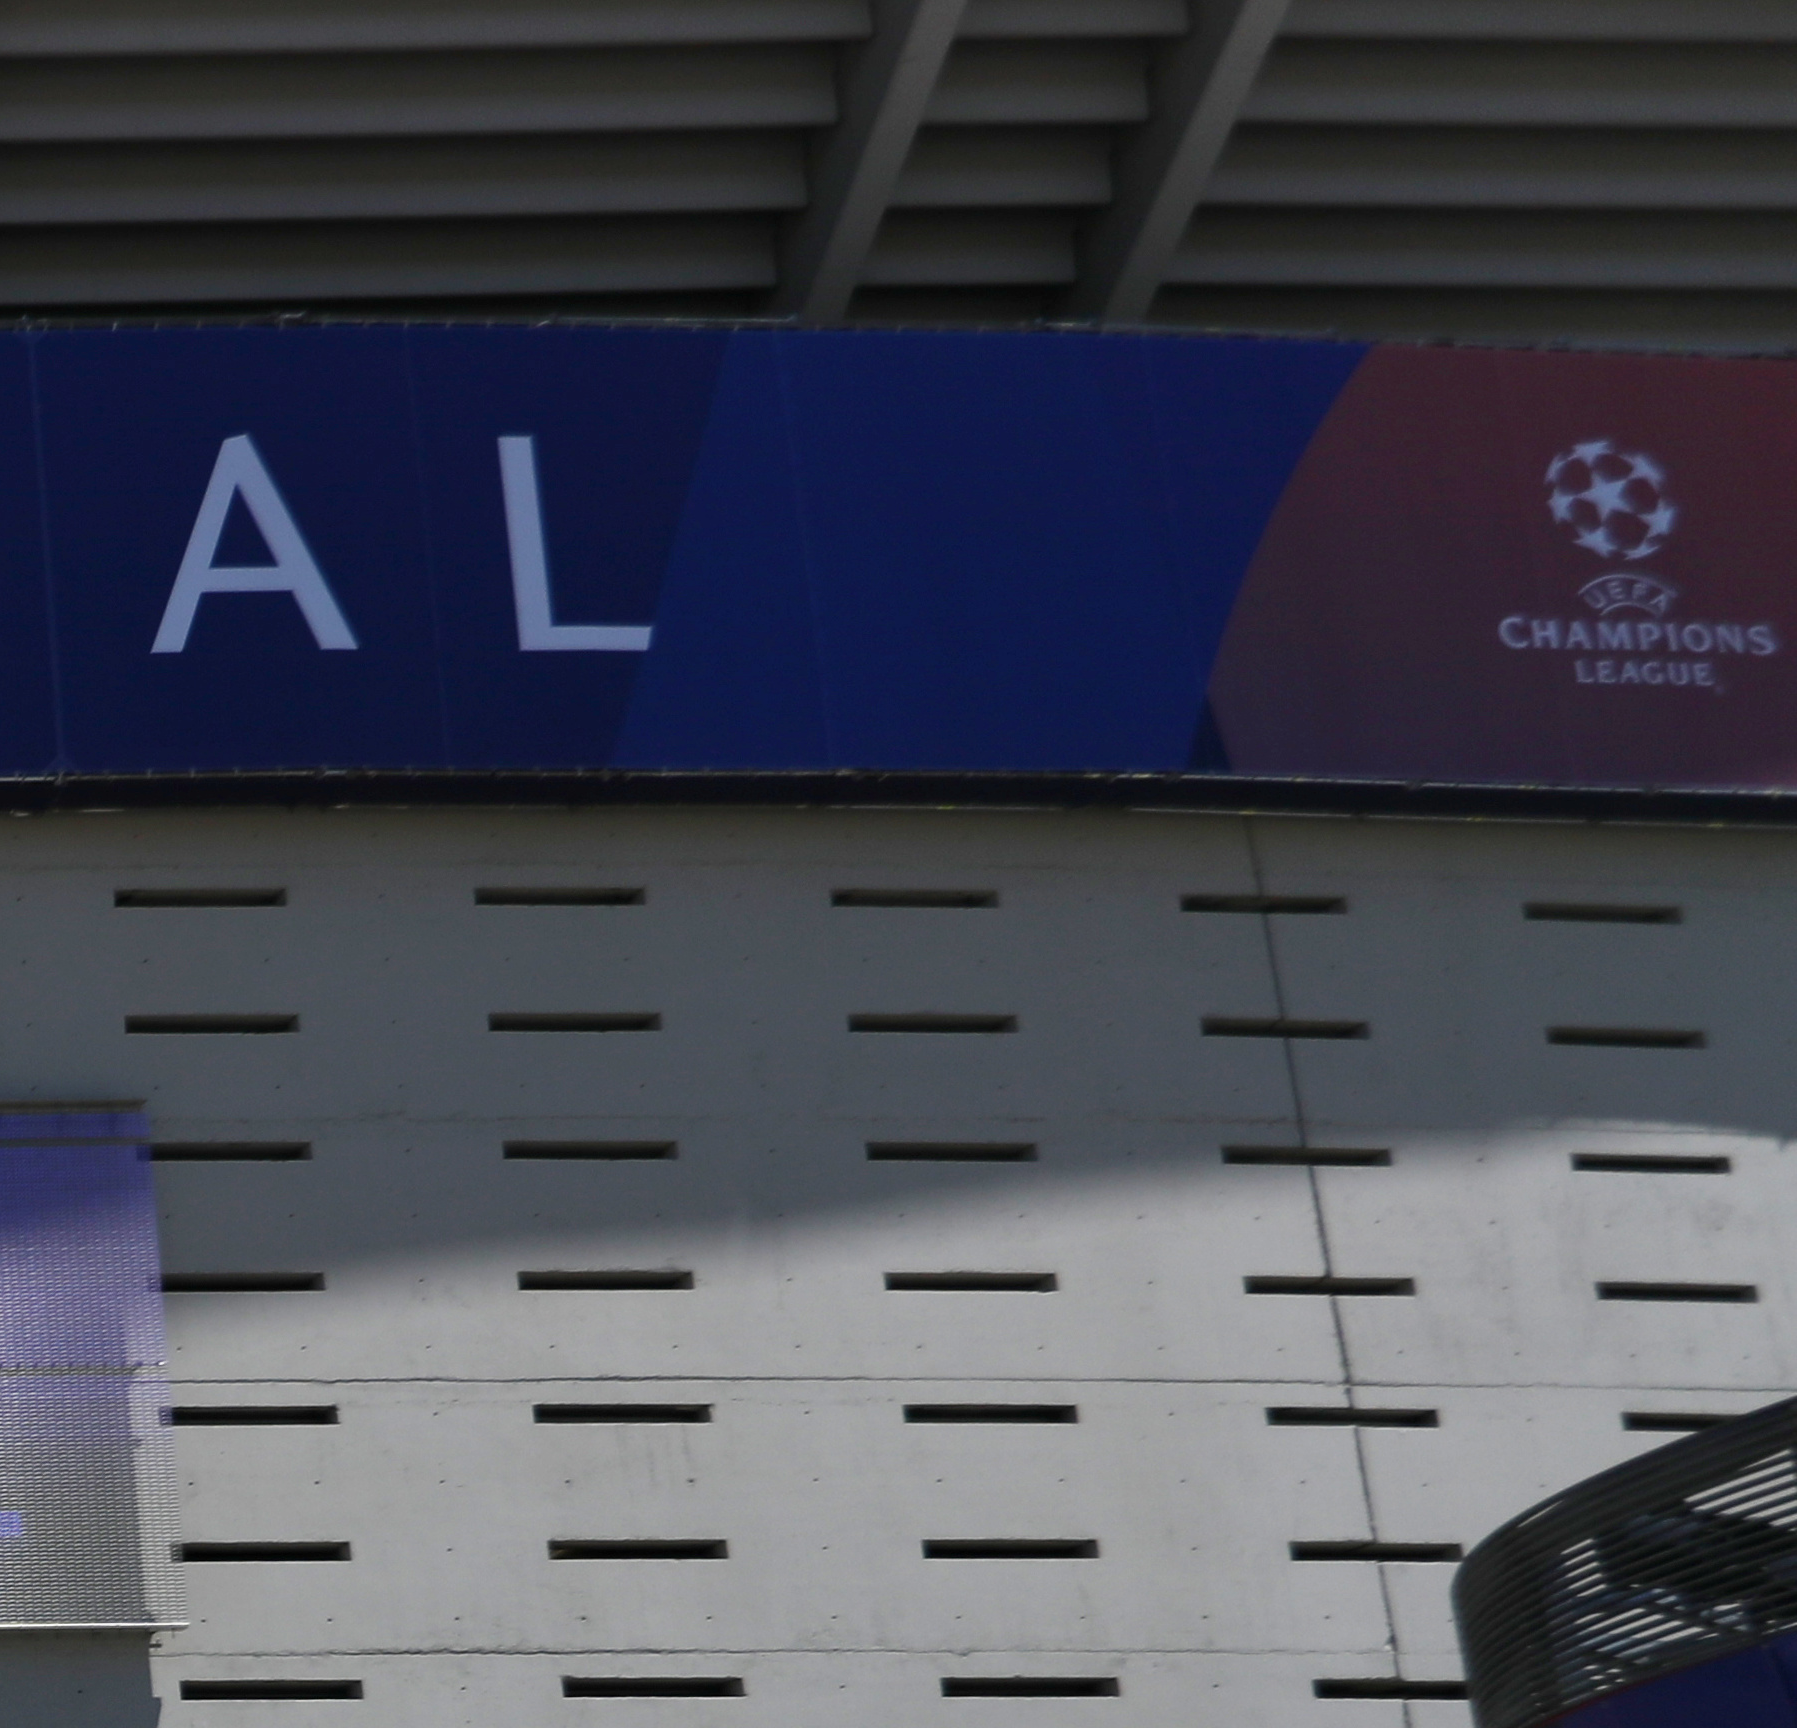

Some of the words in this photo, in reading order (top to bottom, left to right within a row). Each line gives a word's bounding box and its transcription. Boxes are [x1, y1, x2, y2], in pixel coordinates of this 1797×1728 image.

[1583, 581, 1673, 613] UEFA
[1498, 616, 1777, 656] CHAMPIONS
[1574, 660, 1716, 686] LEAGUE
